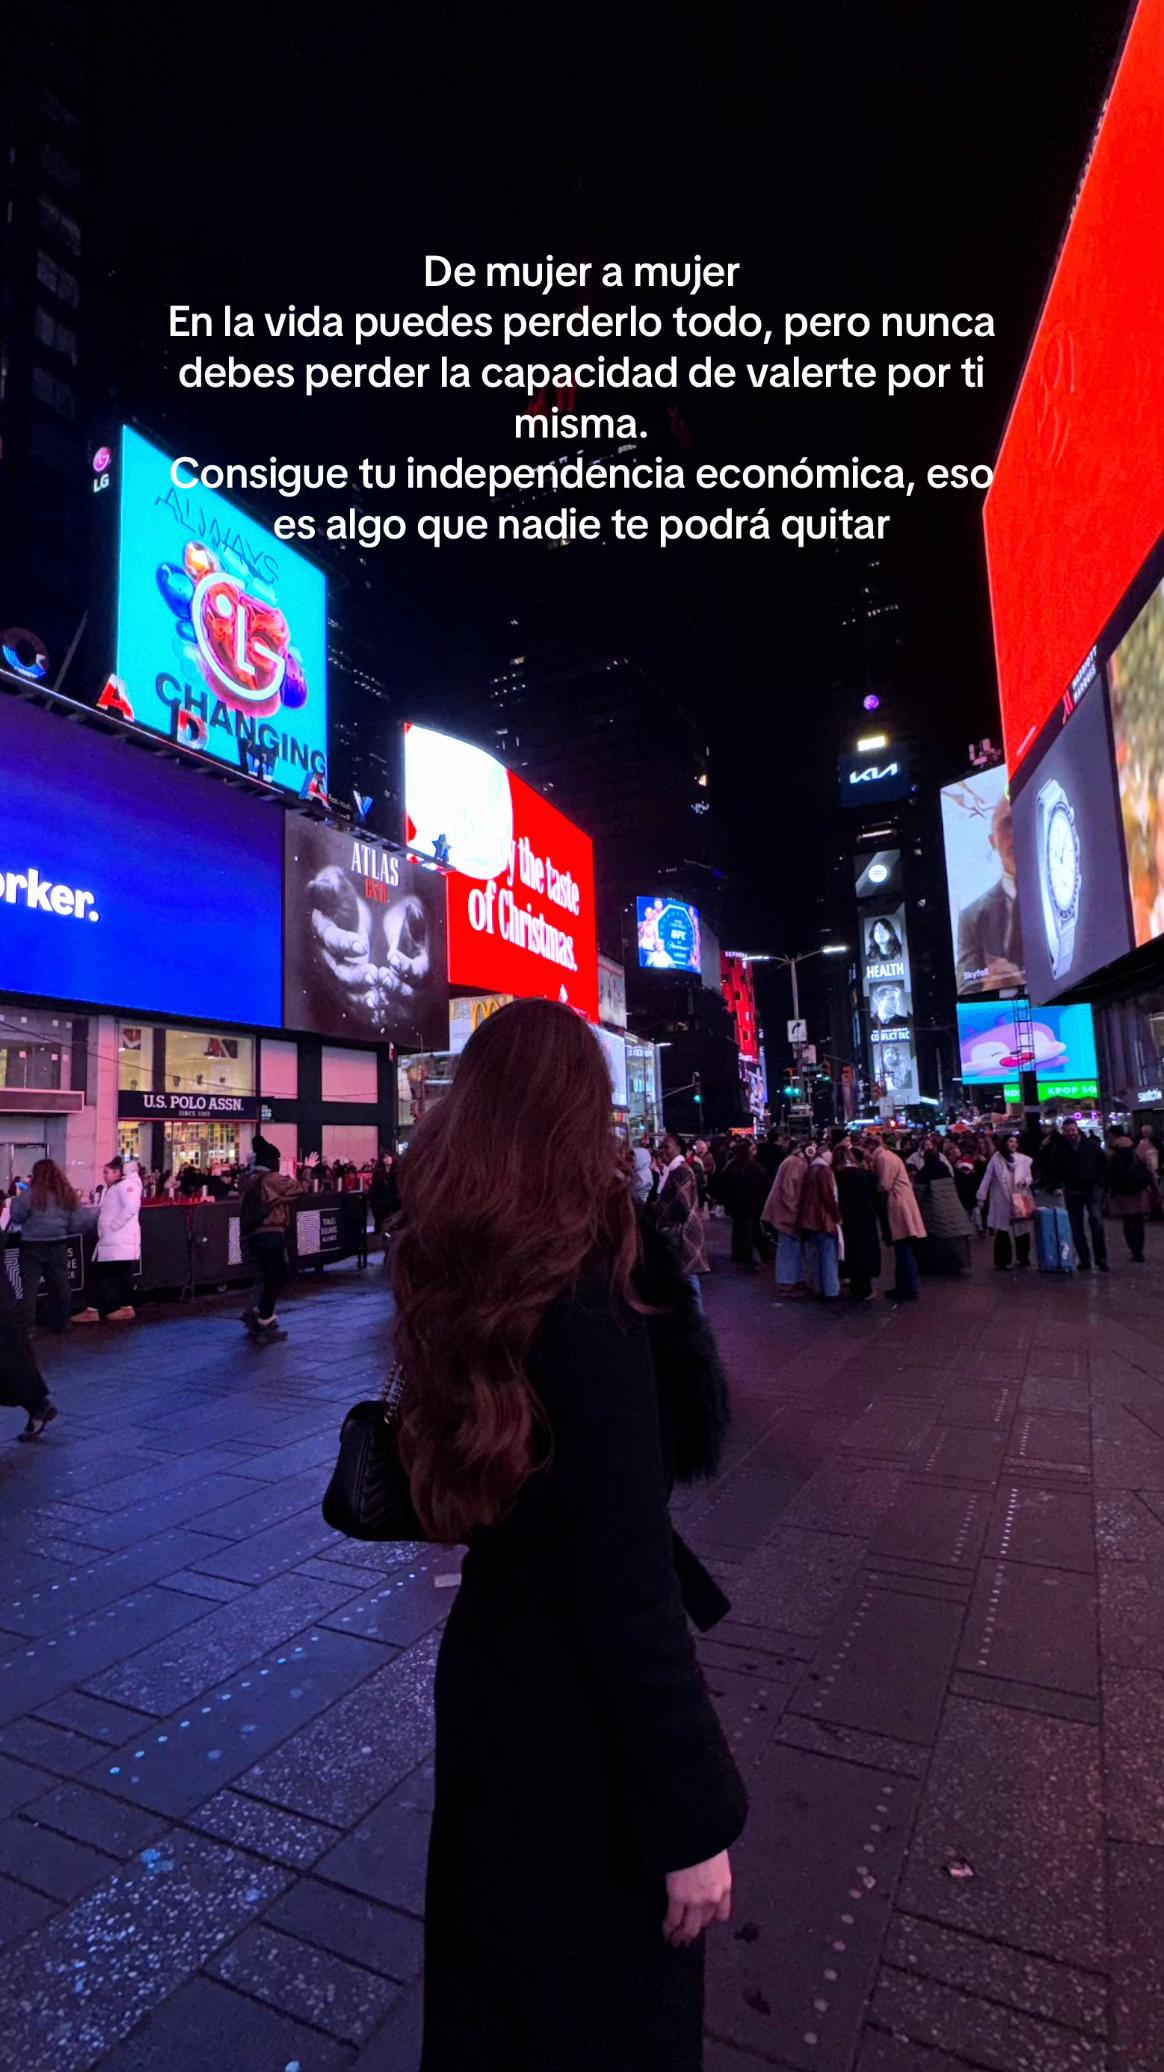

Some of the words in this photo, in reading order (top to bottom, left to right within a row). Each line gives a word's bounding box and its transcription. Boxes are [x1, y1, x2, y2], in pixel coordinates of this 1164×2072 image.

[93, 473, 110, 493] LG
[155, 671, 327, 774] CHANGING
[849, 762, 898, 784] KIA
[351, 842, 399, 887] ATLAS
[518, 836, 545, 895] the
[546, 856, 580, 916] taste
[0, 867, 100, 922] rker.
[467, 880, 497, 935] of
[498, 888, 579, 972] Christmas.
[866, 962, 905, 979] HEALTH
[143, 1094, 168, 1109] U.S.
[170, 1095, 208, 1111] POLO
[208, 1098, 244, 1112] ASSN.
